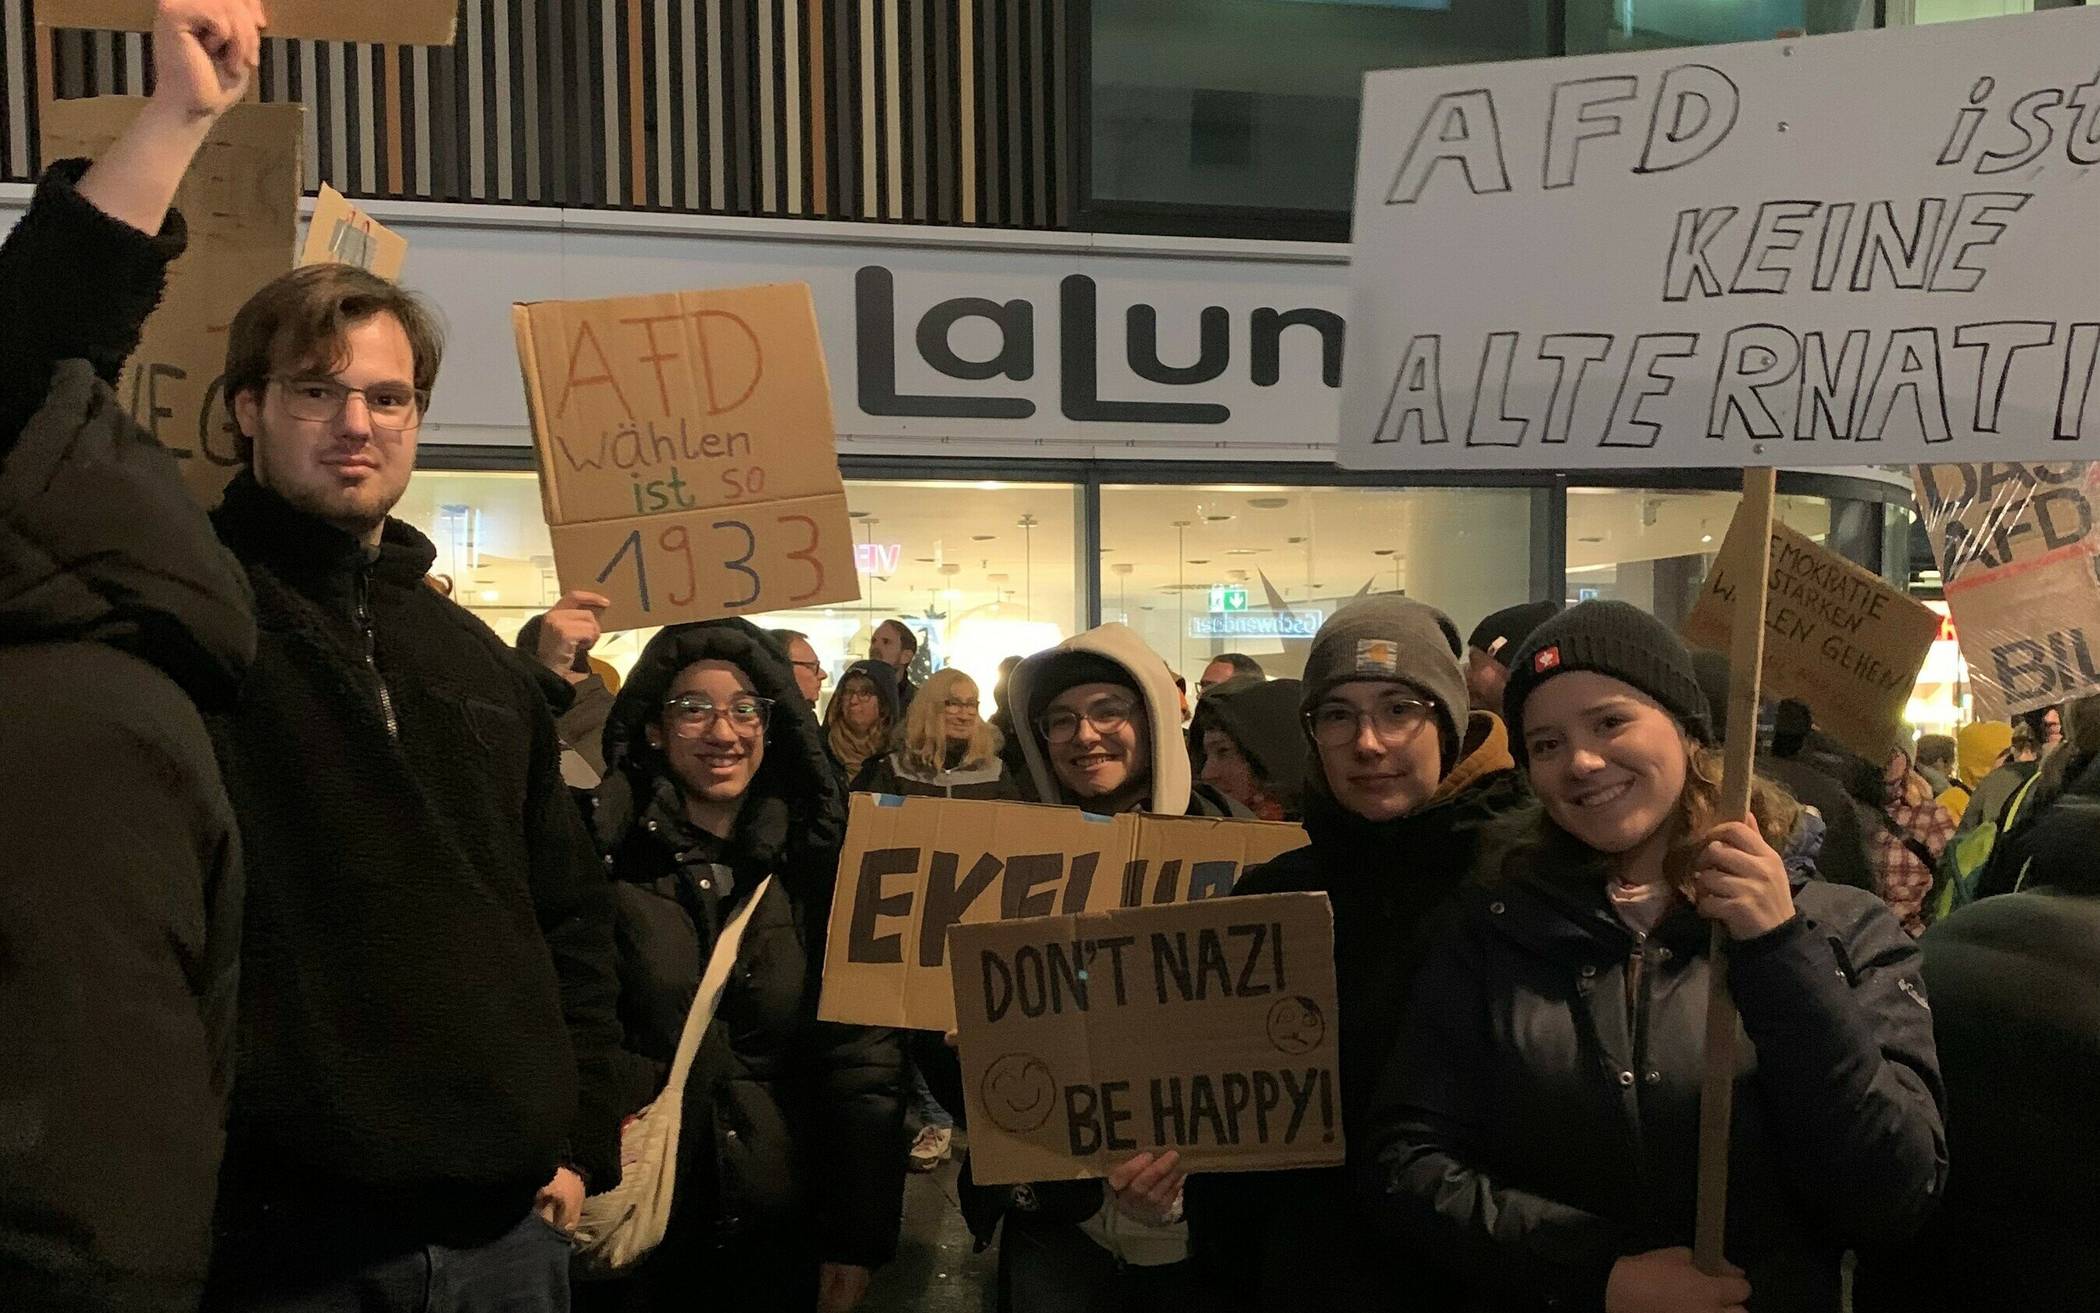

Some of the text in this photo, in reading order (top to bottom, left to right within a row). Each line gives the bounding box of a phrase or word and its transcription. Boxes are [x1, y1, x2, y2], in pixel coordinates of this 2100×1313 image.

[1385, 63, 1740, 205] AFD
[1662, 191, 2033, 302] KEINE
[556, 309, 763, 419] AFD
[1373, 321, 2100, 448] ALTERNATI
[631, 466, 765, 514] ist so
[1943, 487, 2092, 583] AFD
[596, 515, 825, 612] 1933
[1769, 534, 1889, 621] EMOKRATIE
[980, 922, 1287, 1023] DON'T NAZI
[1064, 1067, 1336, 1156] BE HAPPY!
